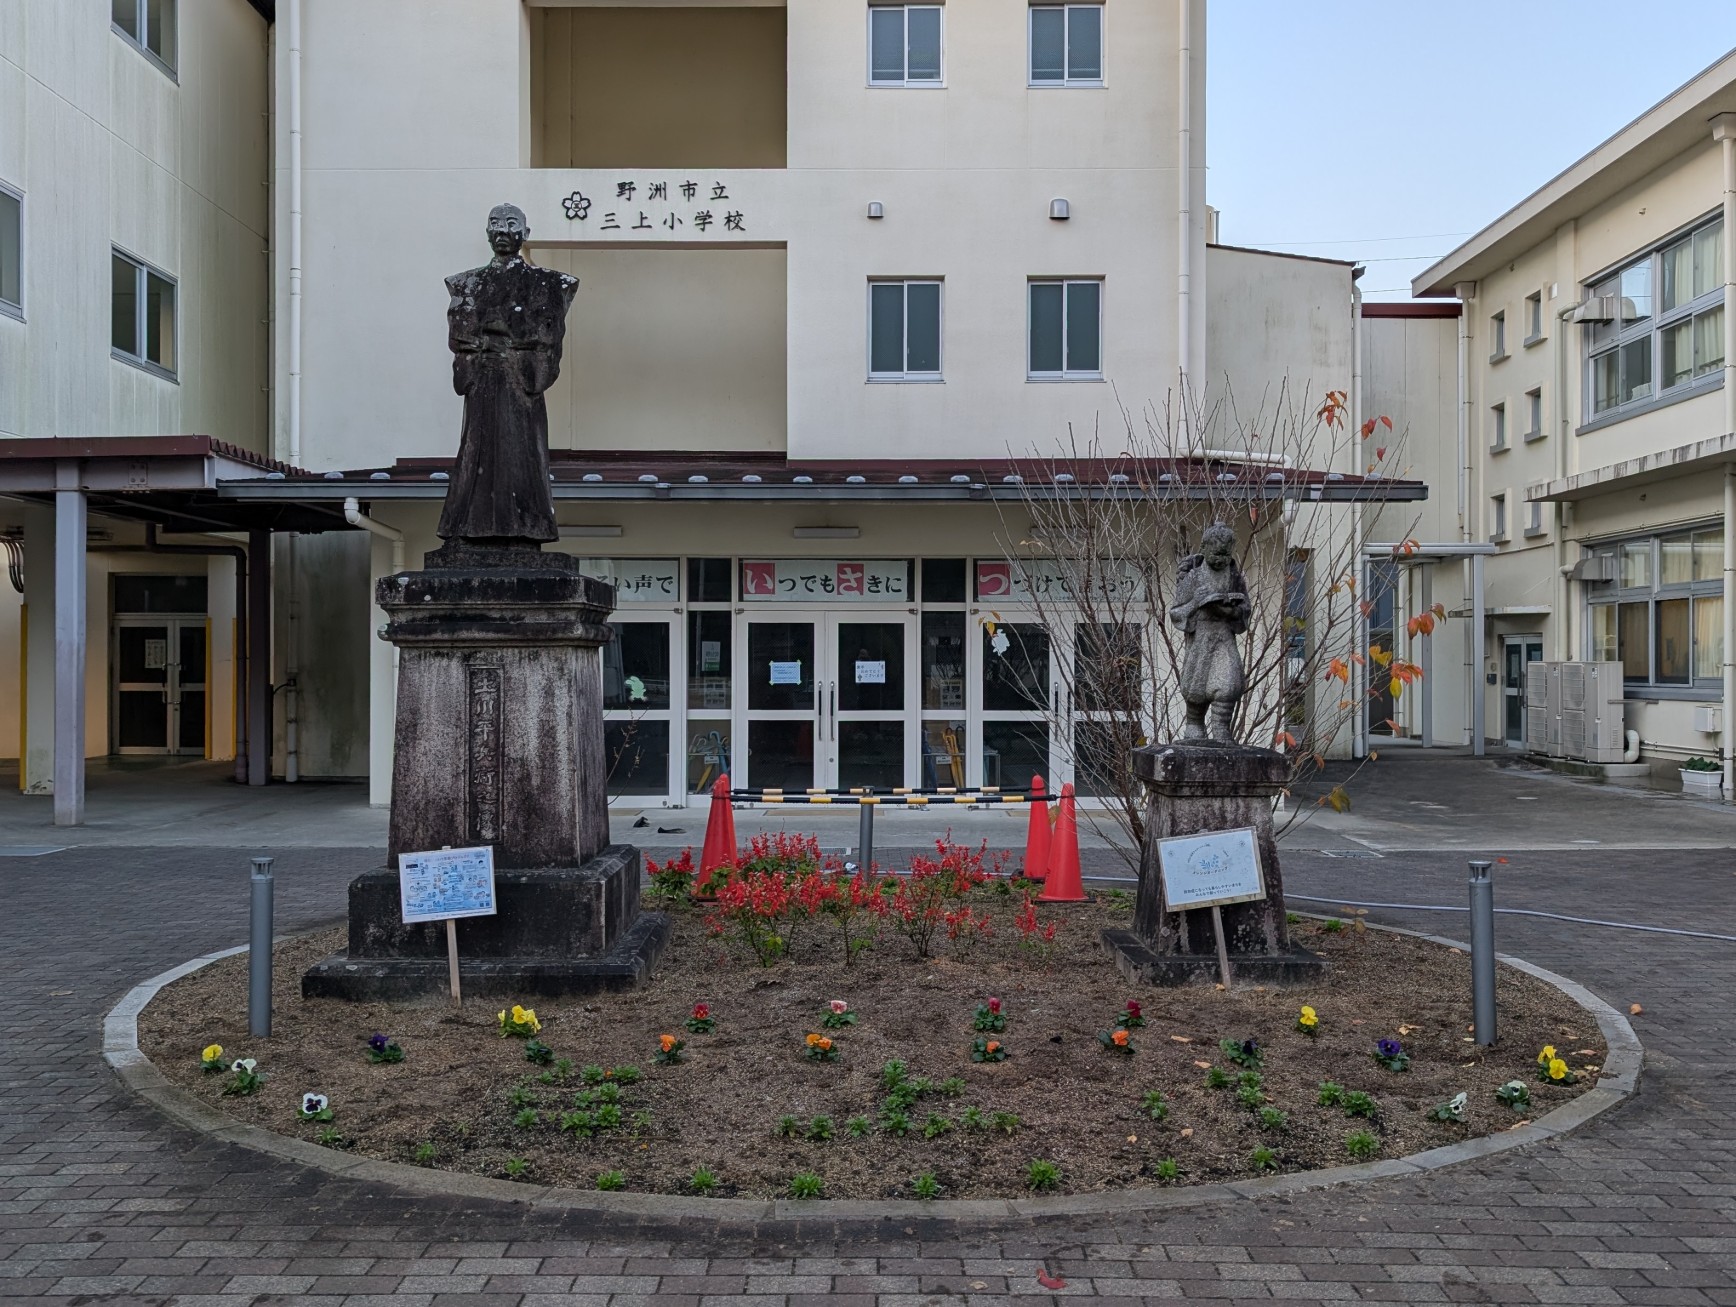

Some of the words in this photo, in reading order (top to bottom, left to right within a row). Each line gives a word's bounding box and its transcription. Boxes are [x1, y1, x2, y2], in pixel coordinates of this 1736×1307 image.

[616, 180, 730, 202] 野洲市立
[600, 210, 746, 232] 三上小学校
[744, 567, 902, 595] いつでもさきに
